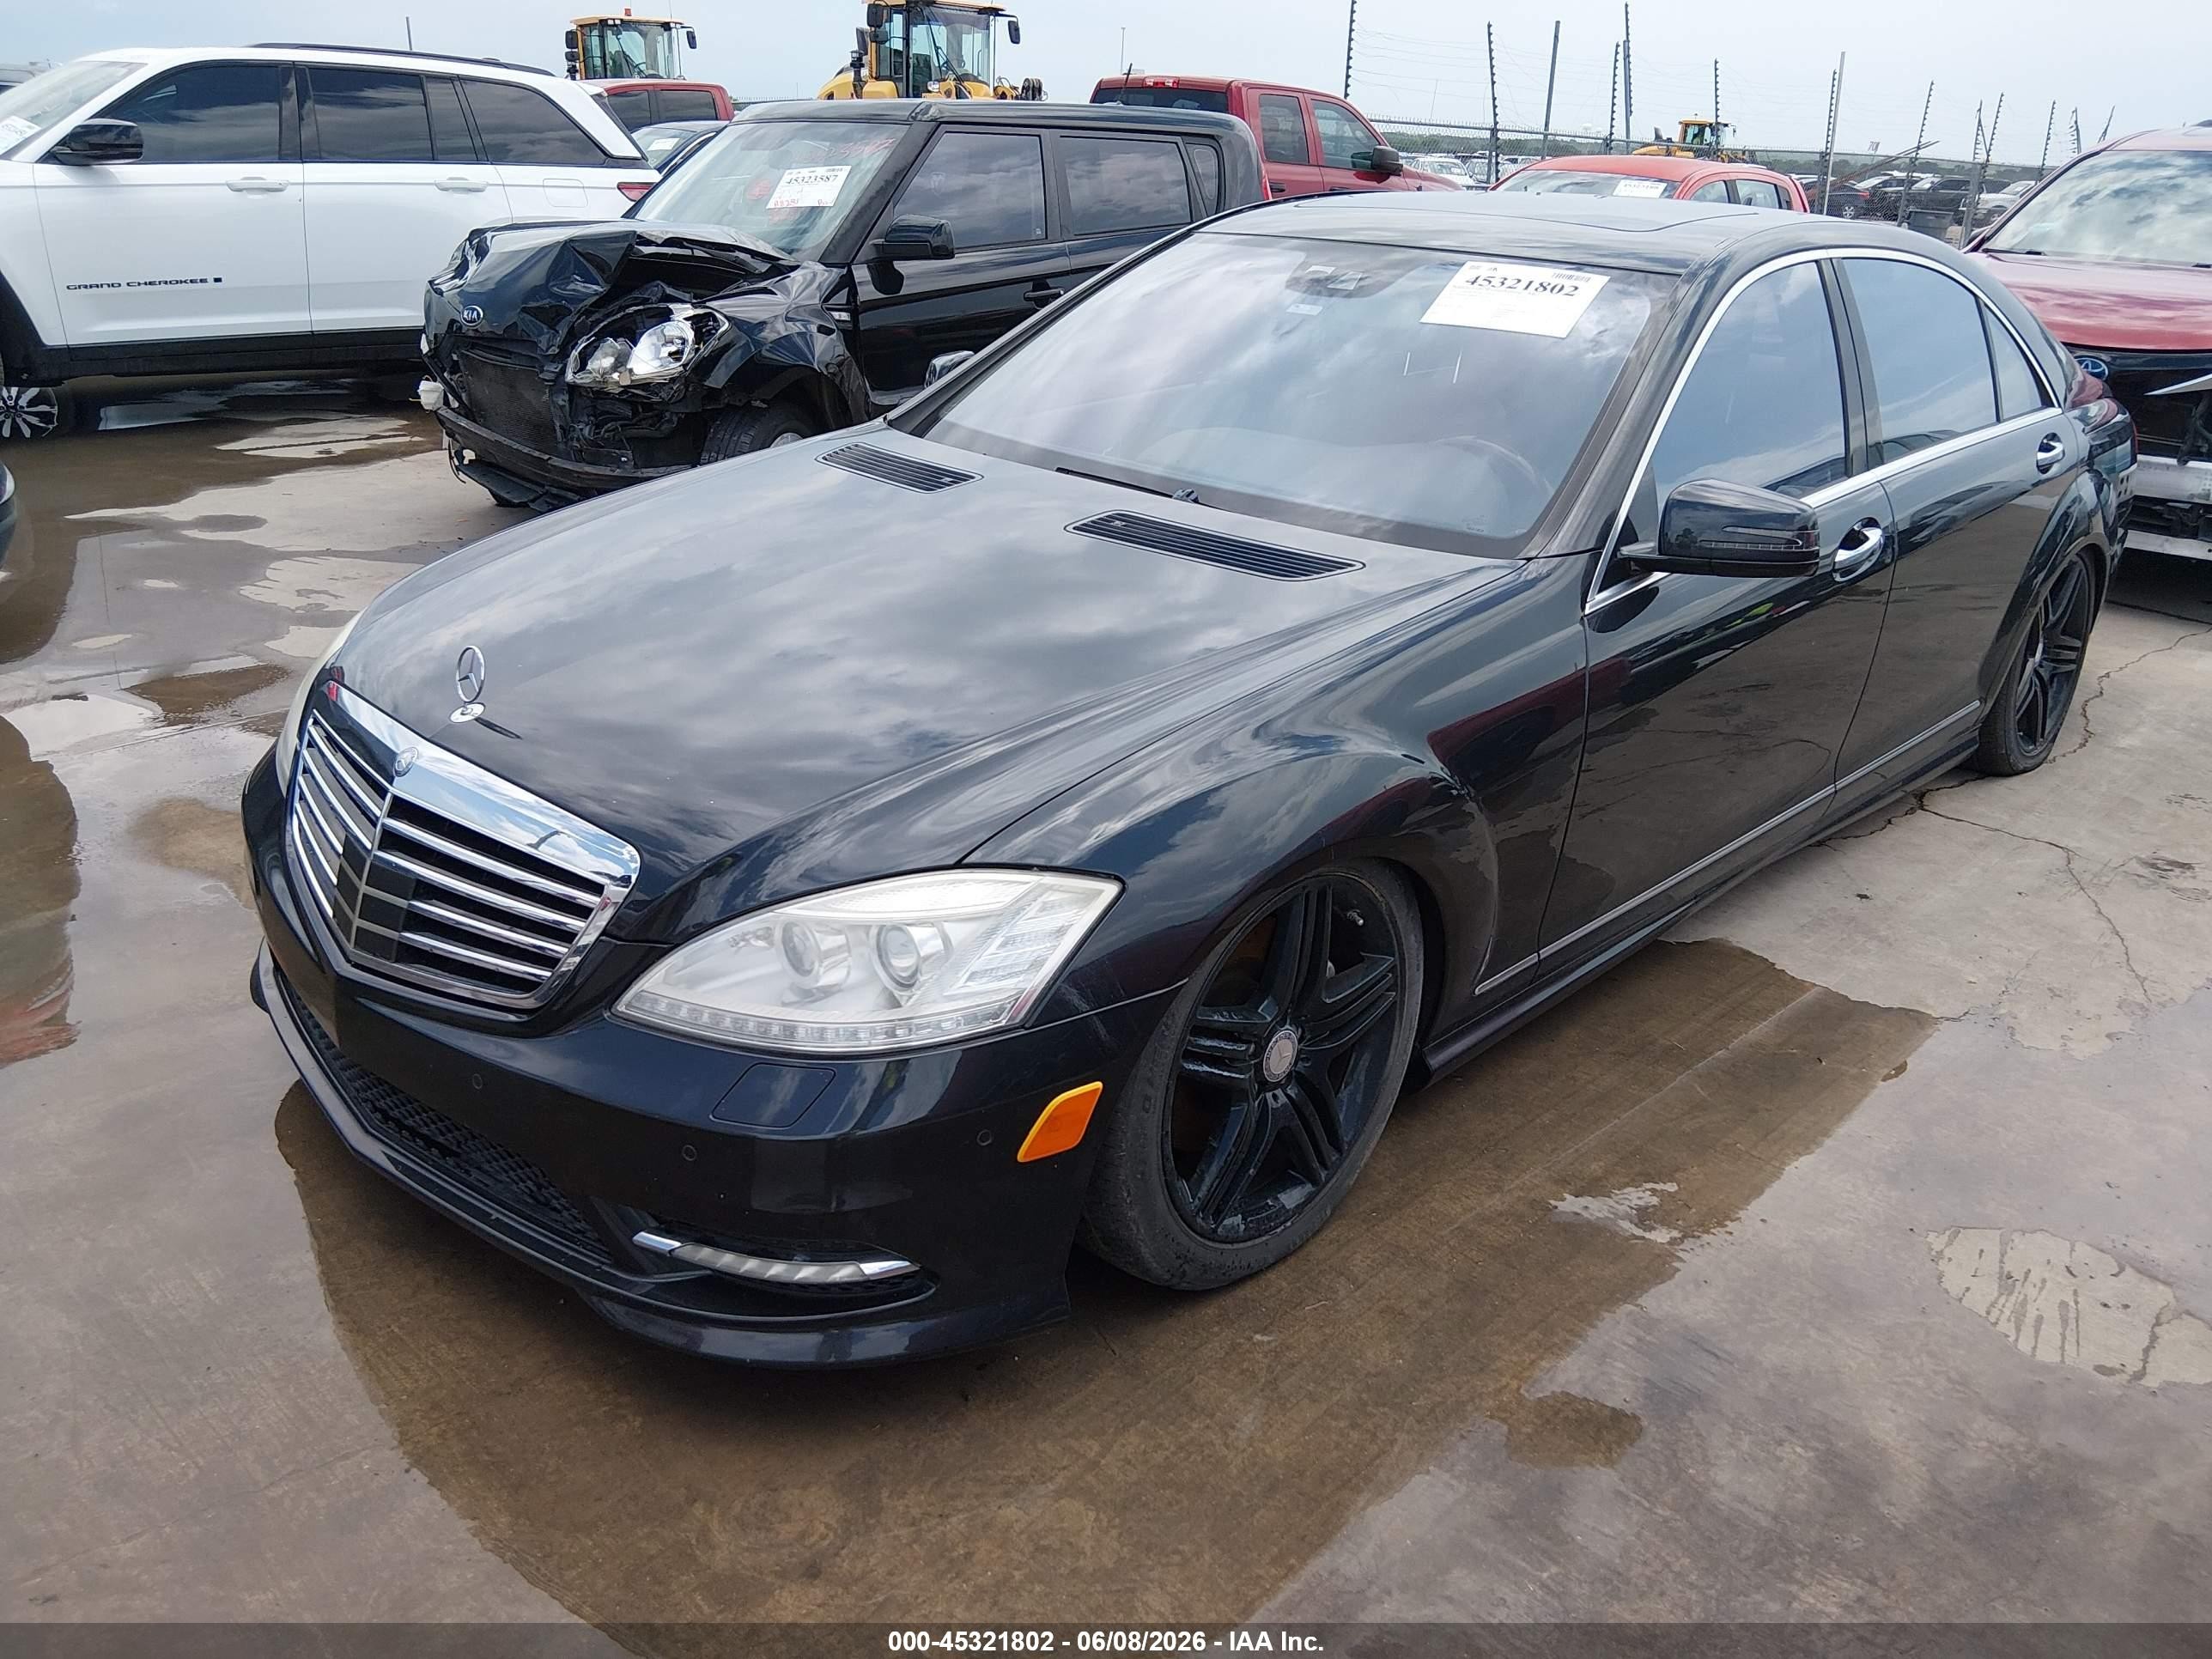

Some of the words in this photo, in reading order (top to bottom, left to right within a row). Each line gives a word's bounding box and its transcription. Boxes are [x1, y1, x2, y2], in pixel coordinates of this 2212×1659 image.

[785, 174, 837, 185] 45323587
[66, 282, 122, 290] GRAND
[126, 277, 209, 287] CHEROKEE
[1466, 274, 1580, 297] 45321802
[463, 310, 478, 321] KIA
